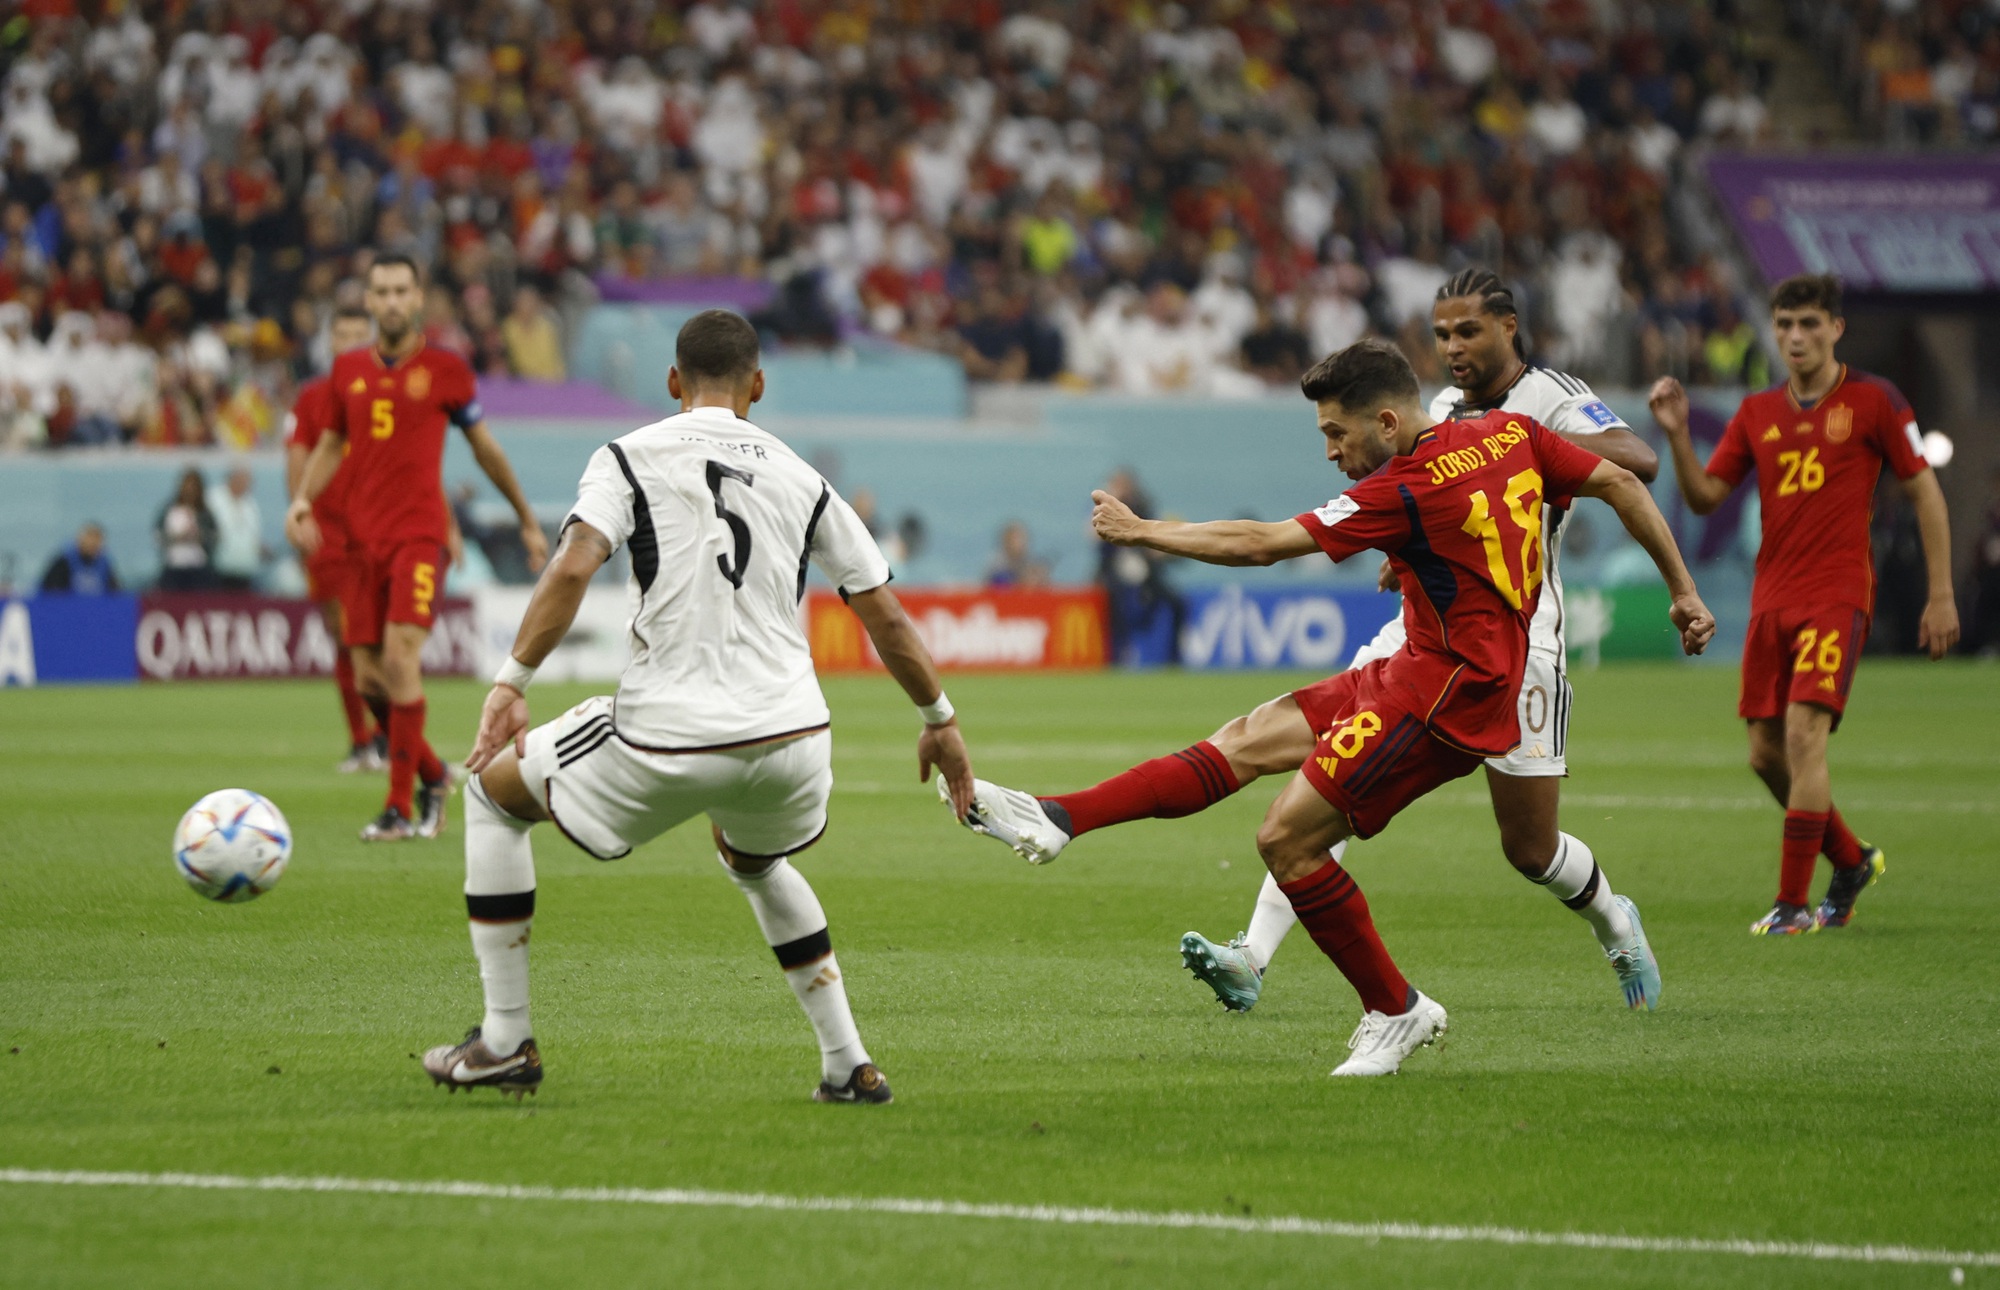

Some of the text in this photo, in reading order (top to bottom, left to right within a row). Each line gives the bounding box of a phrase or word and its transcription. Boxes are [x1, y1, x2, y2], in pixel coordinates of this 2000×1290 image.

[371, 398, 395, 440] 5
[1424, 420, 1529, 485] JORDI ALBA
[1777, 446, 1825, 497] 26
[705, 459, 754, 590] 5
[1460, 467, 1544, 611] 18
[413, 562, 436, 602] 5
[135, 610, 293, 681] QATAR
[1794, 628, 1843, 673] 26
[1323, 708, 1382, 759] 8
[1525, 684, 1549, 734] 0
